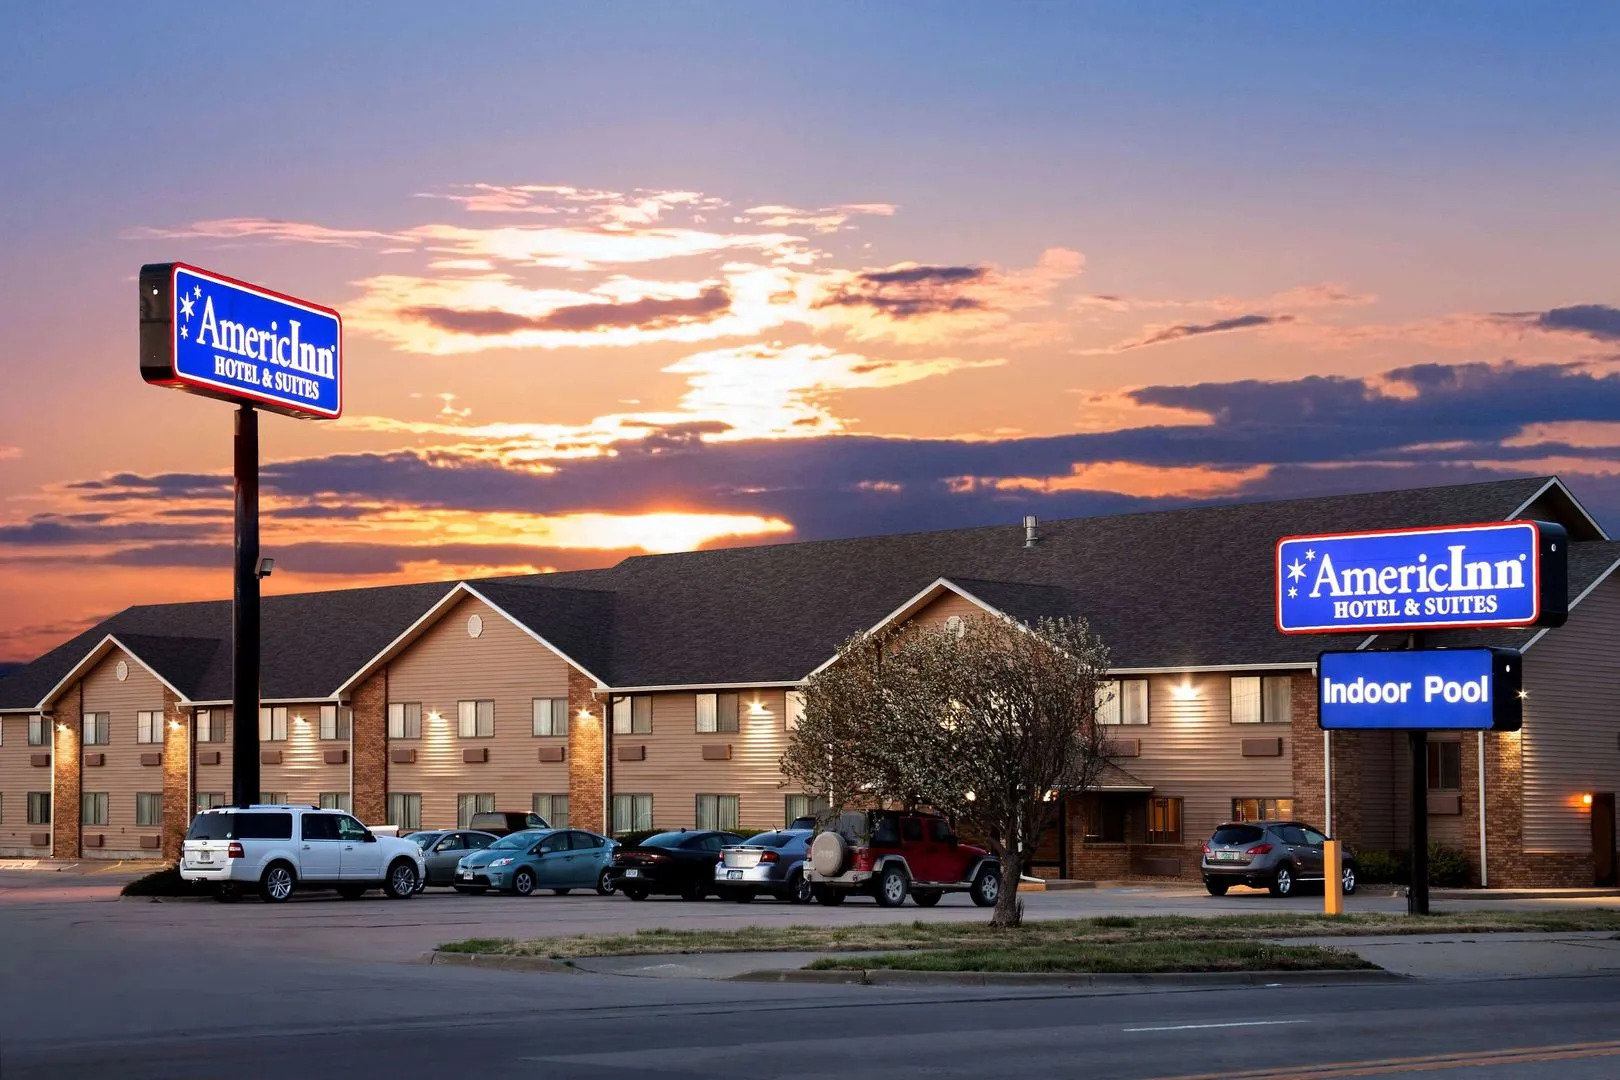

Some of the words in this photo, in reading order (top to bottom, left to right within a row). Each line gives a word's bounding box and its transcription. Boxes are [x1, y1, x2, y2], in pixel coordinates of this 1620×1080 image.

[197, 296, 335, 379] AmericInn
[215, 355, 260, 385] HOTEL
[262, 368, 273, 388] &
[275, 372, 320, 400] SUITES
[1309, 545, 1525, 598] AmericInn
[1334, 599, 1400, 619] HOTEL
[1404, 598, 1420, 616] &
[1425, 595, 1498, 615] SUITES
[1324, 677, 1412, 704] Indoor
[1425, 675, 1489, 704] Pool
